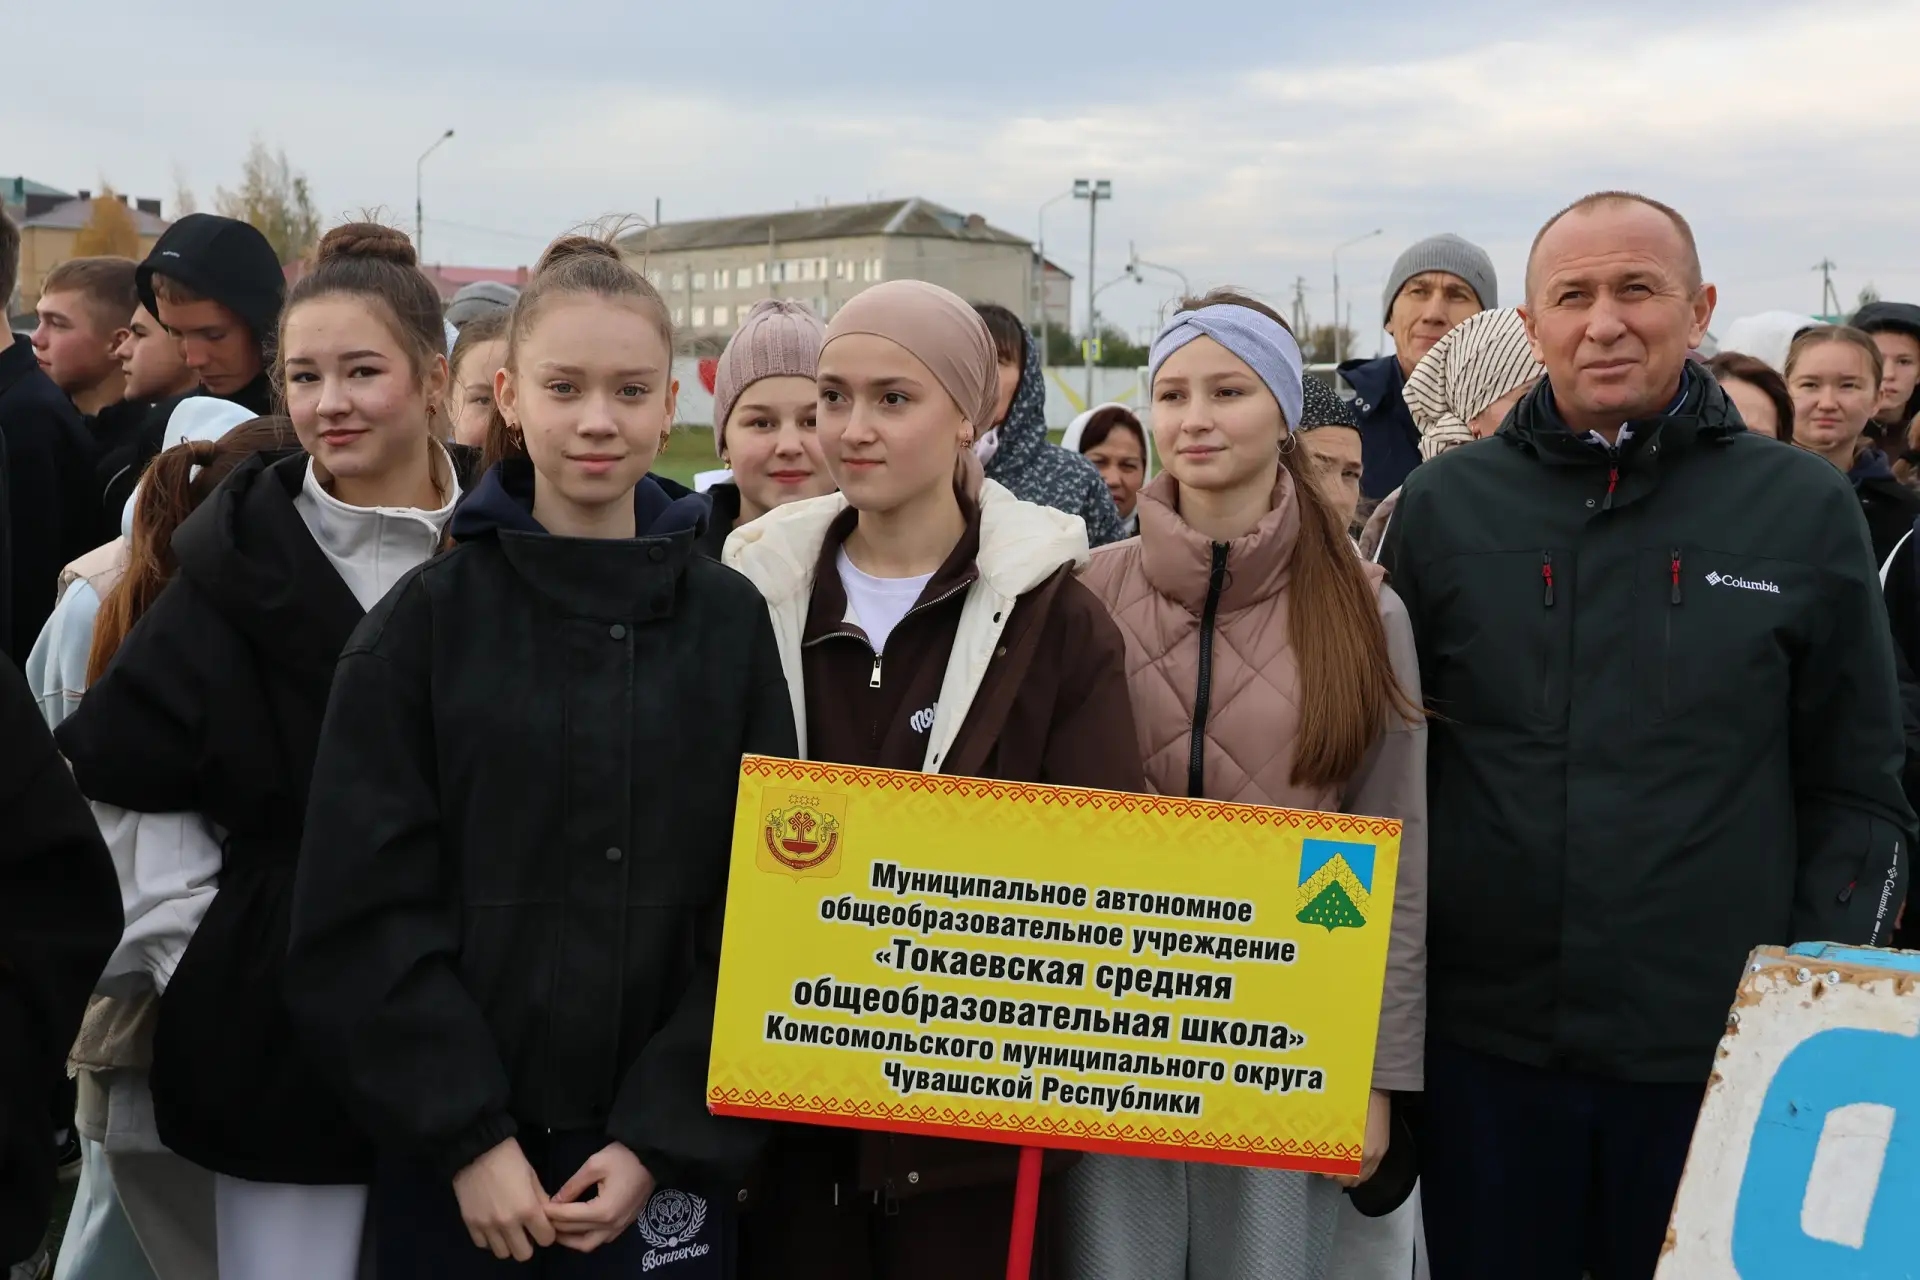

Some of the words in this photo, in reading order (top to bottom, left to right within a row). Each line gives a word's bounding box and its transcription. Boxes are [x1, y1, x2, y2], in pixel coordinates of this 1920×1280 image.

[1721, 574, 1779, 593] Columbia
[872, 862, 1087, 907] Муниципальное
[1095, 889, 1252, 923] автономное
[1876, 879, 1895, 919] Columbia
[821, 896, 1123, 947] общеобразовательное
[1132, 929, 1295, 963] учреждение
[875, 938, 1085, 986] «Токаевская
[1095, 965, 1232, 1000] средняя
[794, 977, 1170, 1039] общеобразовательная
[1181, 1017, 1304, 1050] школа»
[766, 1014, 994, 1060] Комсомольского
[1002, 1043, 1225, 1081] муниципального
[1234, 1063, 1323, 1092] округа
[884, 1061, 1033, 1100] Чувашской
[1041, 1076, 1201, 1115] Республики
